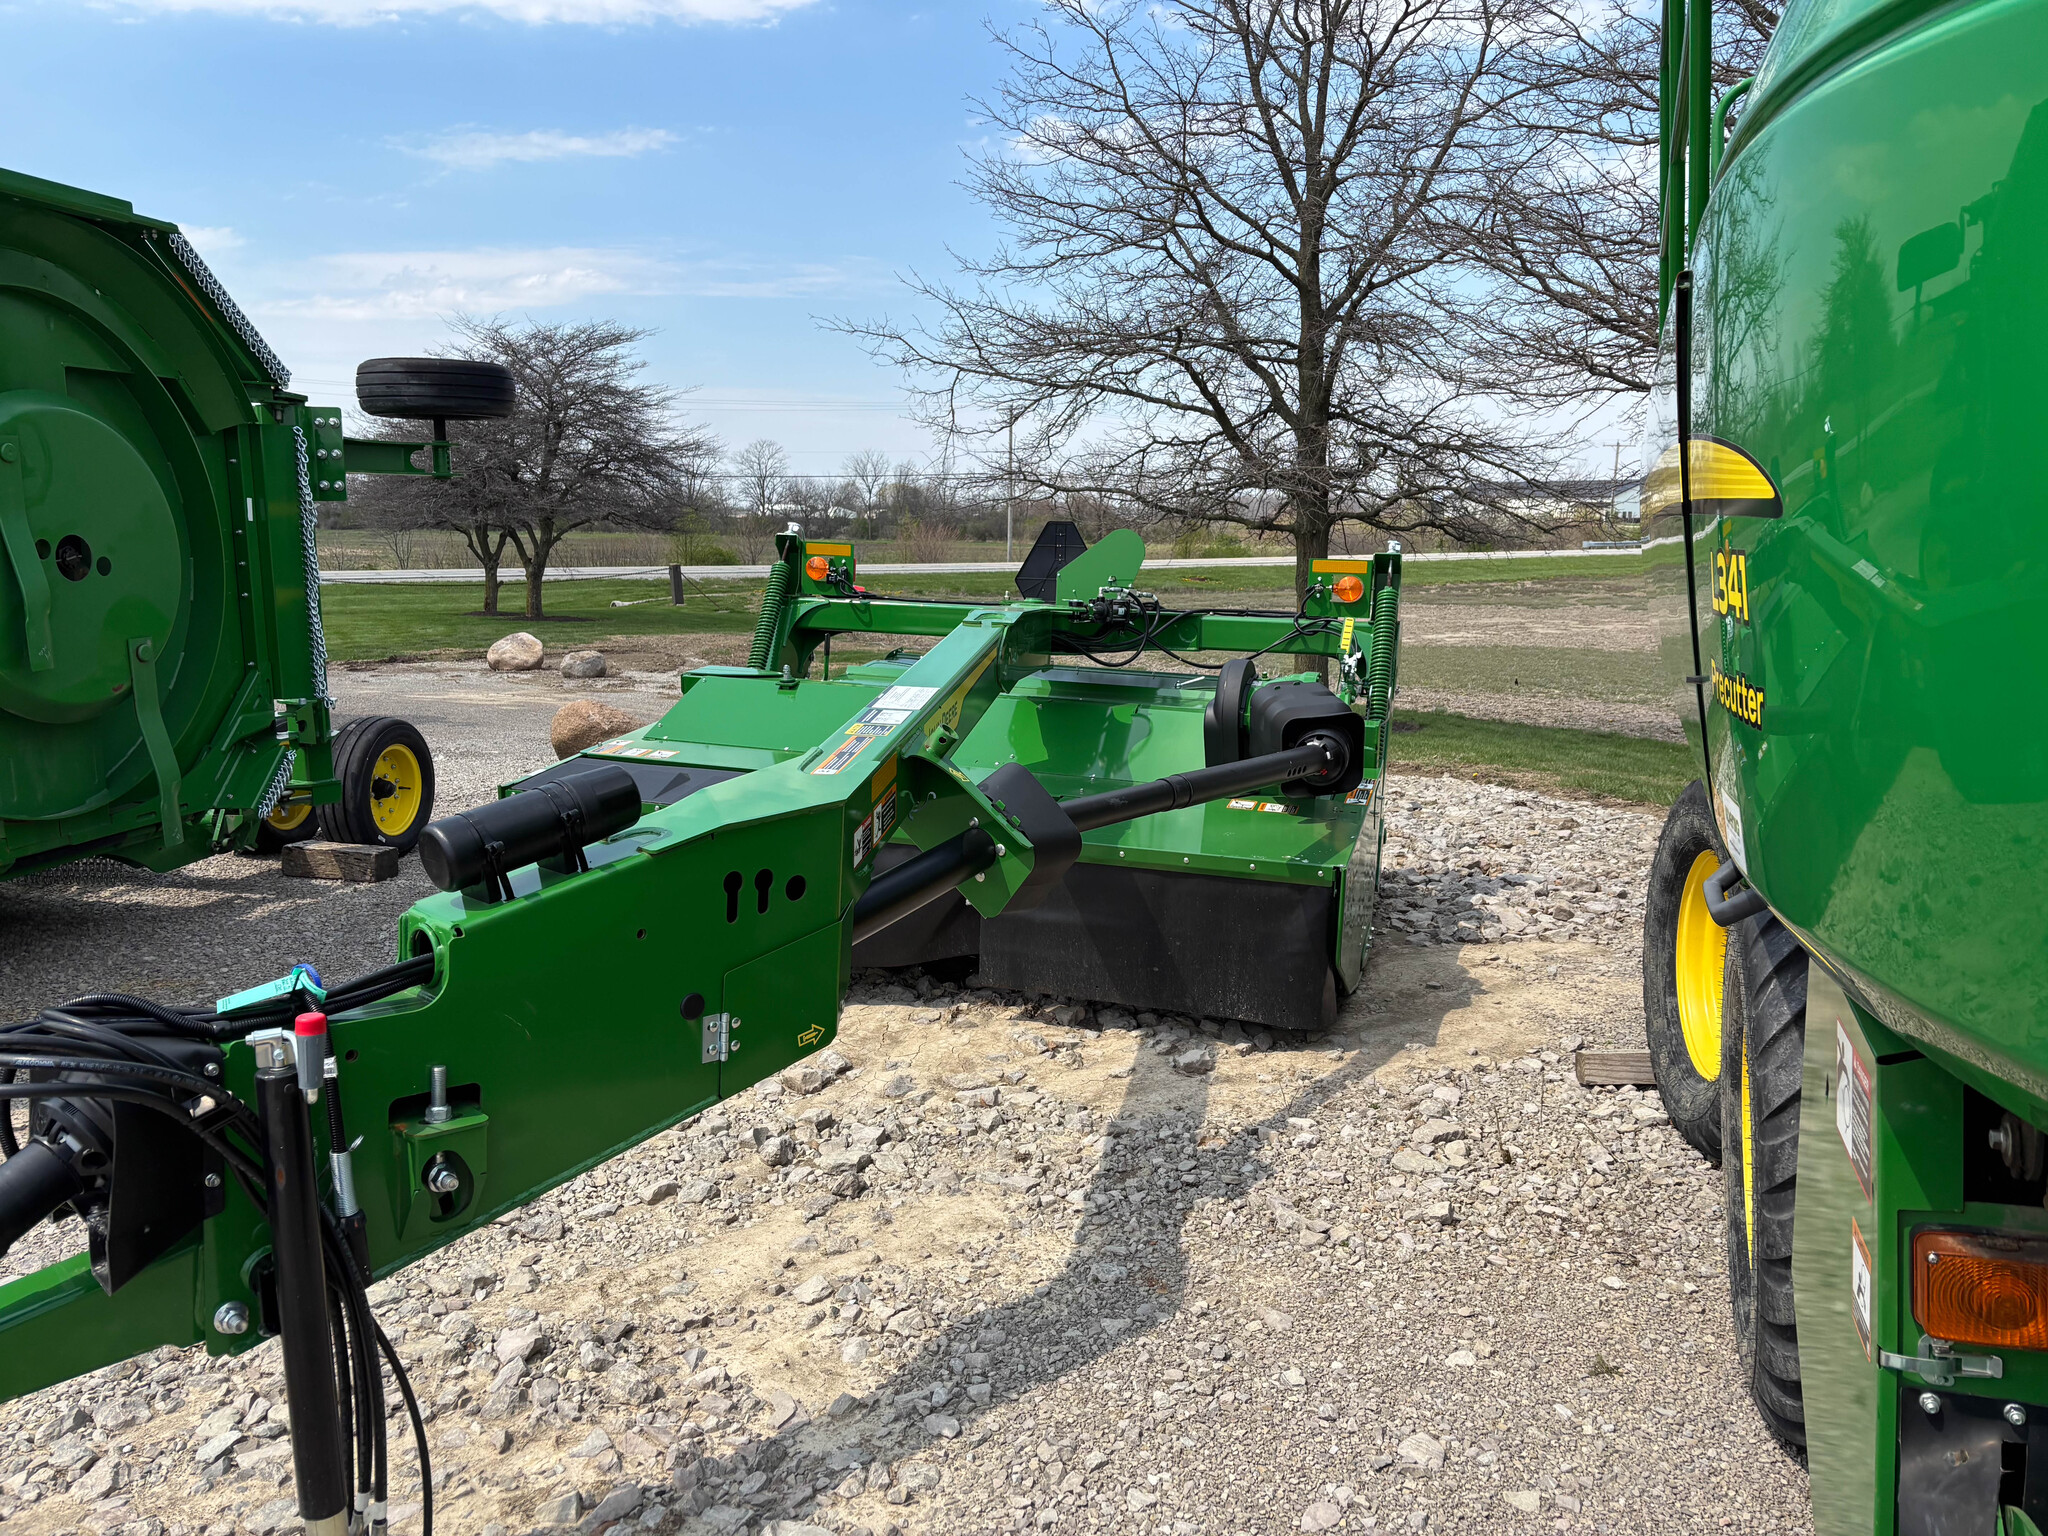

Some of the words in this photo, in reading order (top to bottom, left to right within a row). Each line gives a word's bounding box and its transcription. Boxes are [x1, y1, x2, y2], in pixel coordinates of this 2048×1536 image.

[1710, 549, 1750, 623] L341
[942, 701, 958, 726] DEERE
[1710, 658, 1764, 727] Precutter
